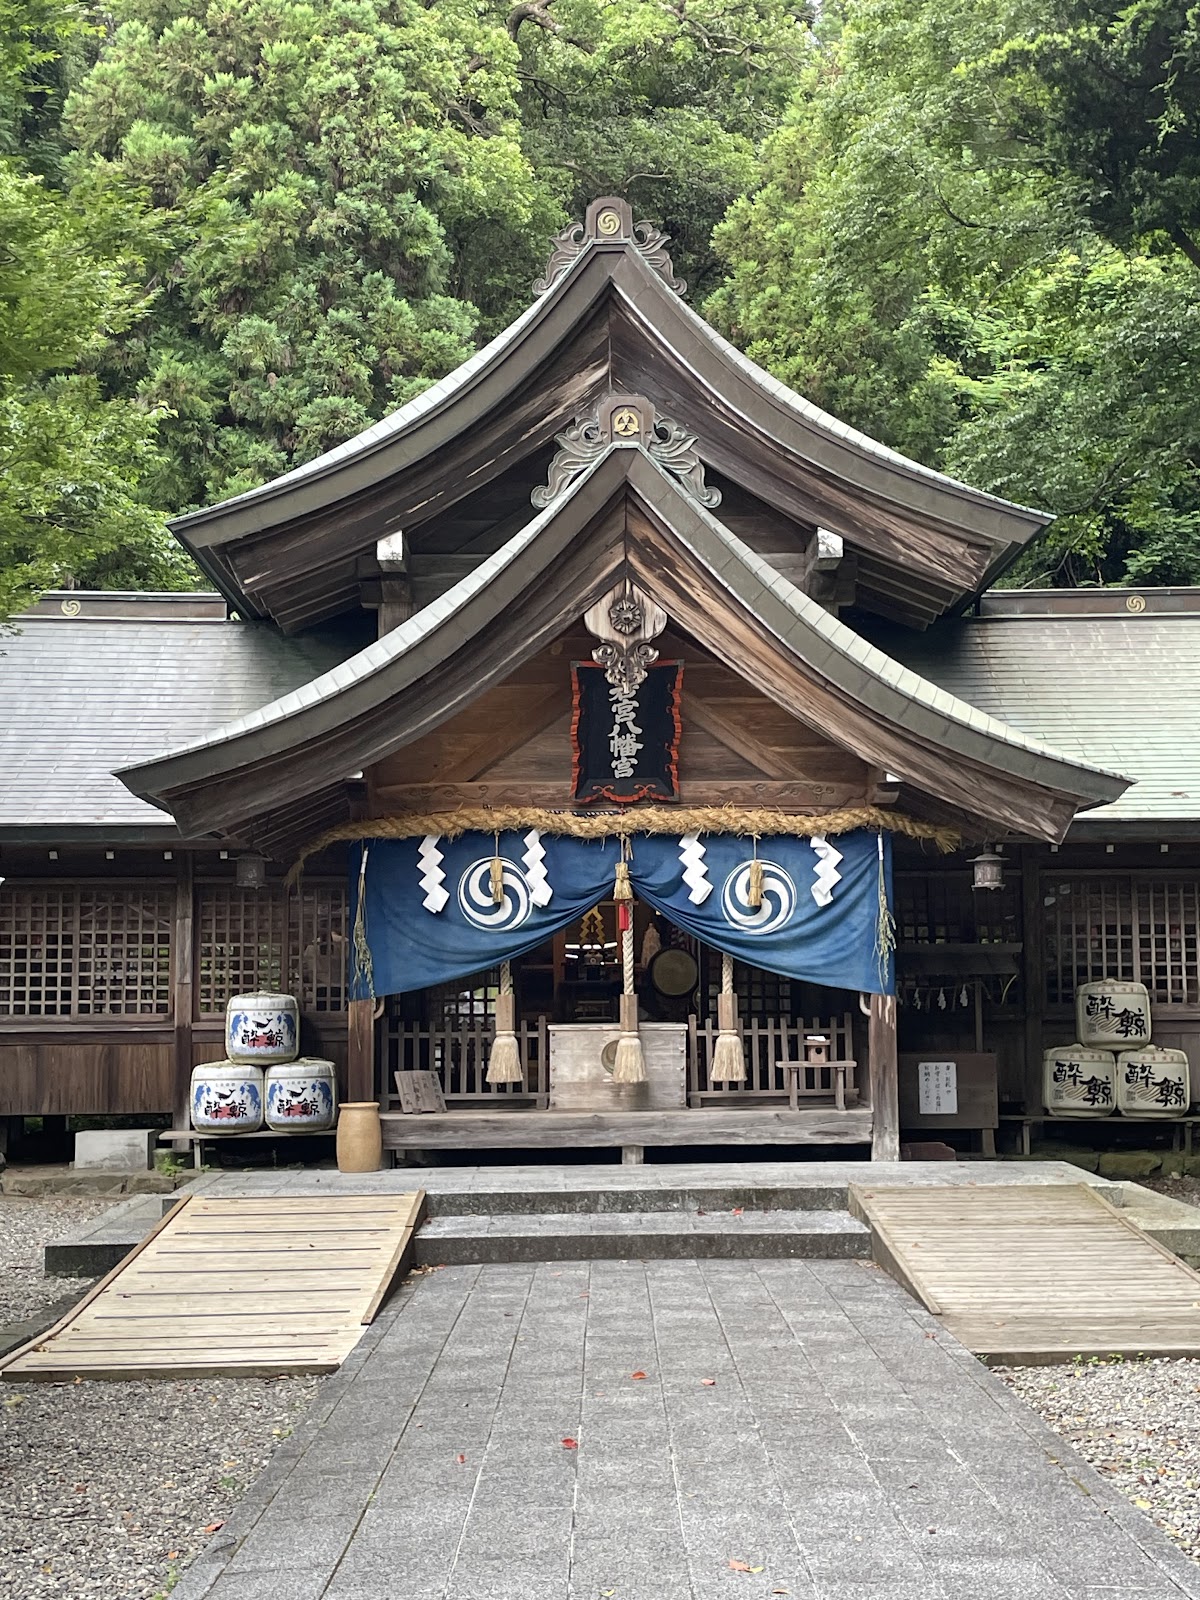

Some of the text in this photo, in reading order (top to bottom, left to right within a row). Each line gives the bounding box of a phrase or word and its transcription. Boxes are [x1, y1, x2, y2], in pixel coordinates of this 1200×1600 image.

[1085, 995, 1147, 1038] 酔鯨
[241, 1029, 284, 1047] 酔鯨
[1052, 1060, 1112, 1106] 酔鯨
[1125, 1062, 1186, 1107] 酔鯨
[204, 1099, 248, 1118] 酔鯨
[277, 1098, 320, 1117] 酔鯨
